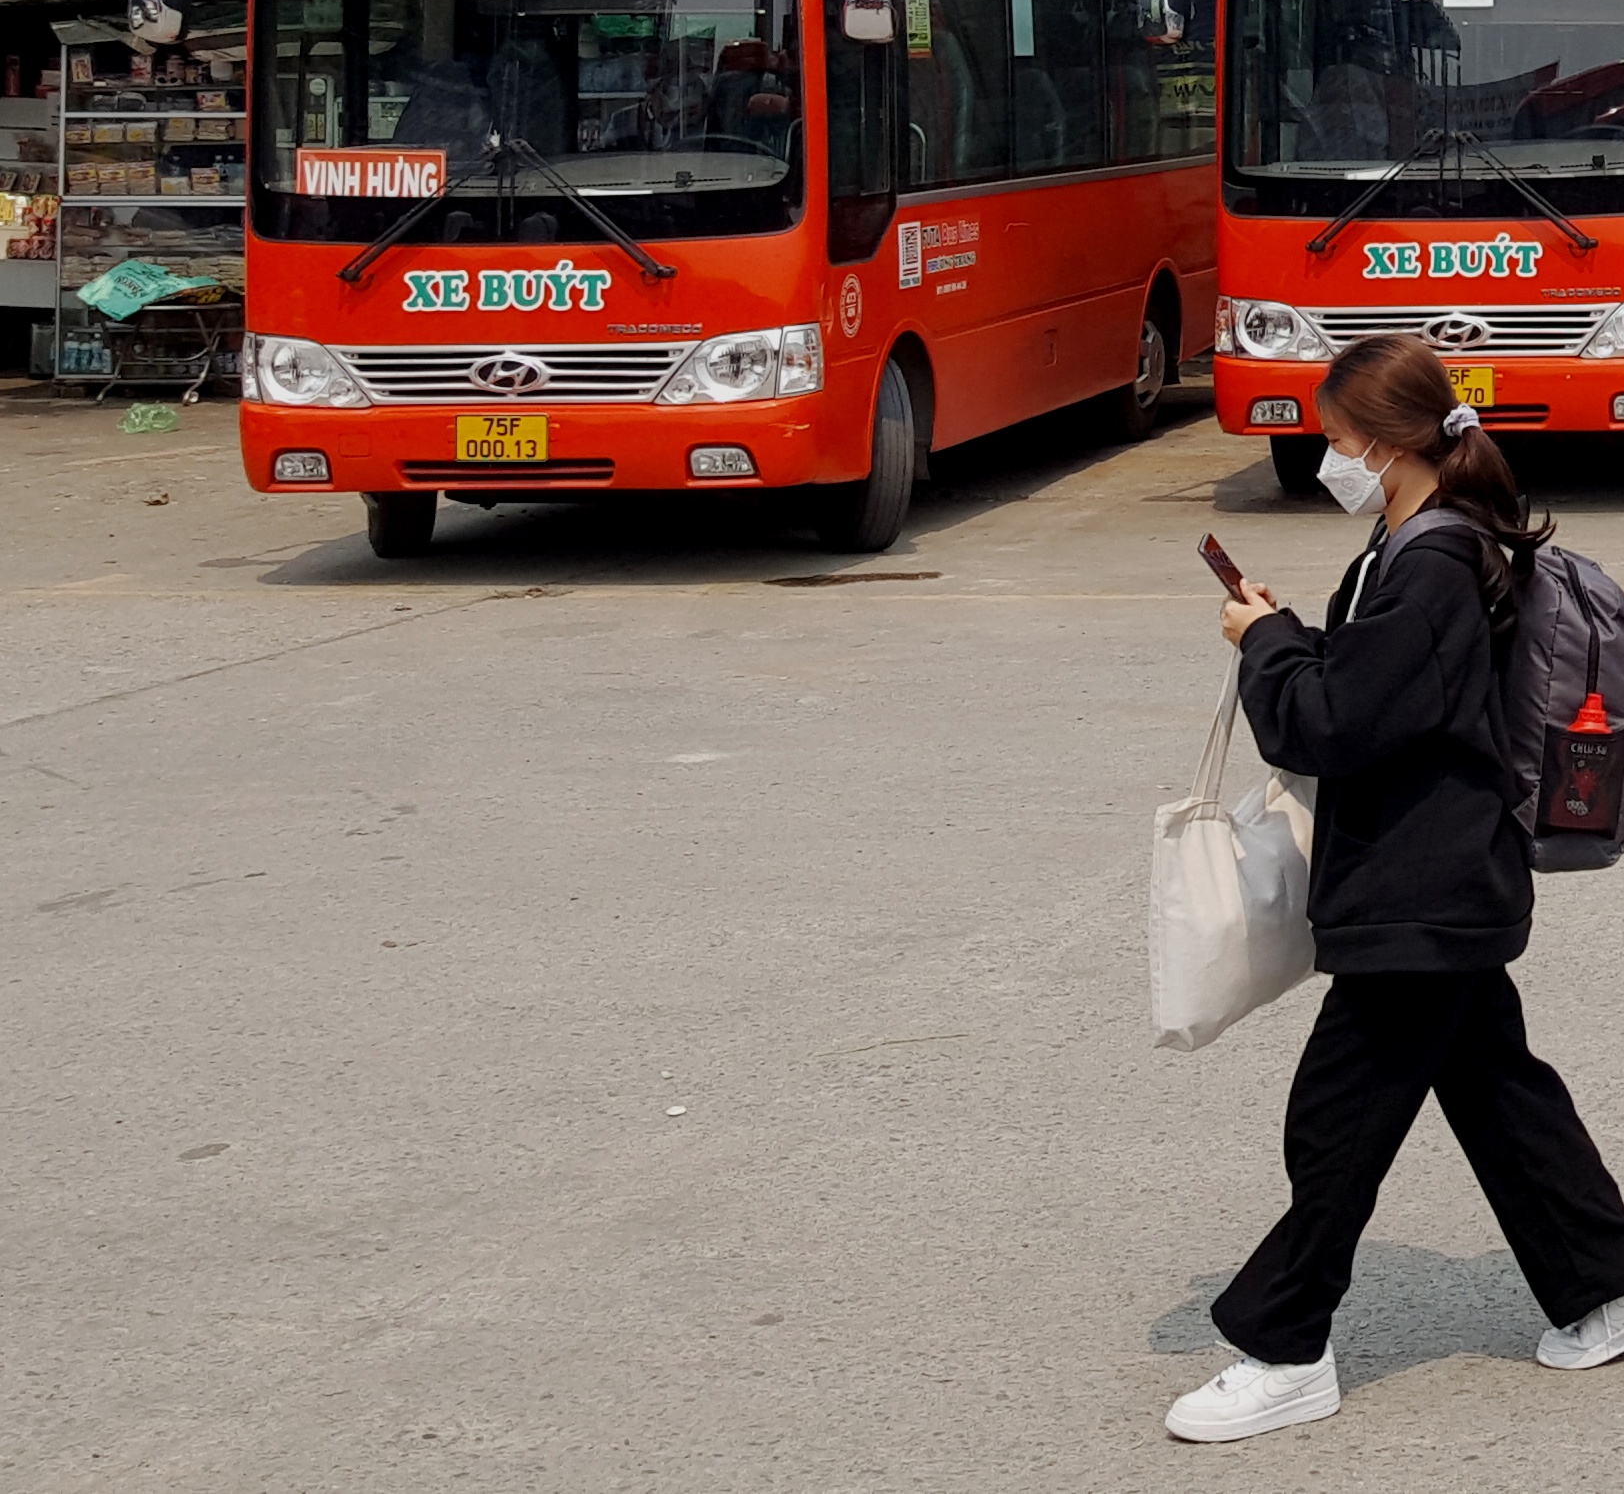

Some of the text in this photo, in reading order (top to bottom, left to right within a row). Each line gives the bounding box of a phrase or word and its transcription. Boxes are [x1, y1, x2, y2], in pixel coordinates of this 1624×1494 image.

[304, 156, 438, 197] VINH HƯNG
[1363, 233, 1543, 279] XE BUÝT
[404, 259, 612, 312] XE BUÝT
[1450, 369, 1471, 386] 5F
[482, 417, 521, 437] 75F
[466, 439, 538, 459] 000.13
